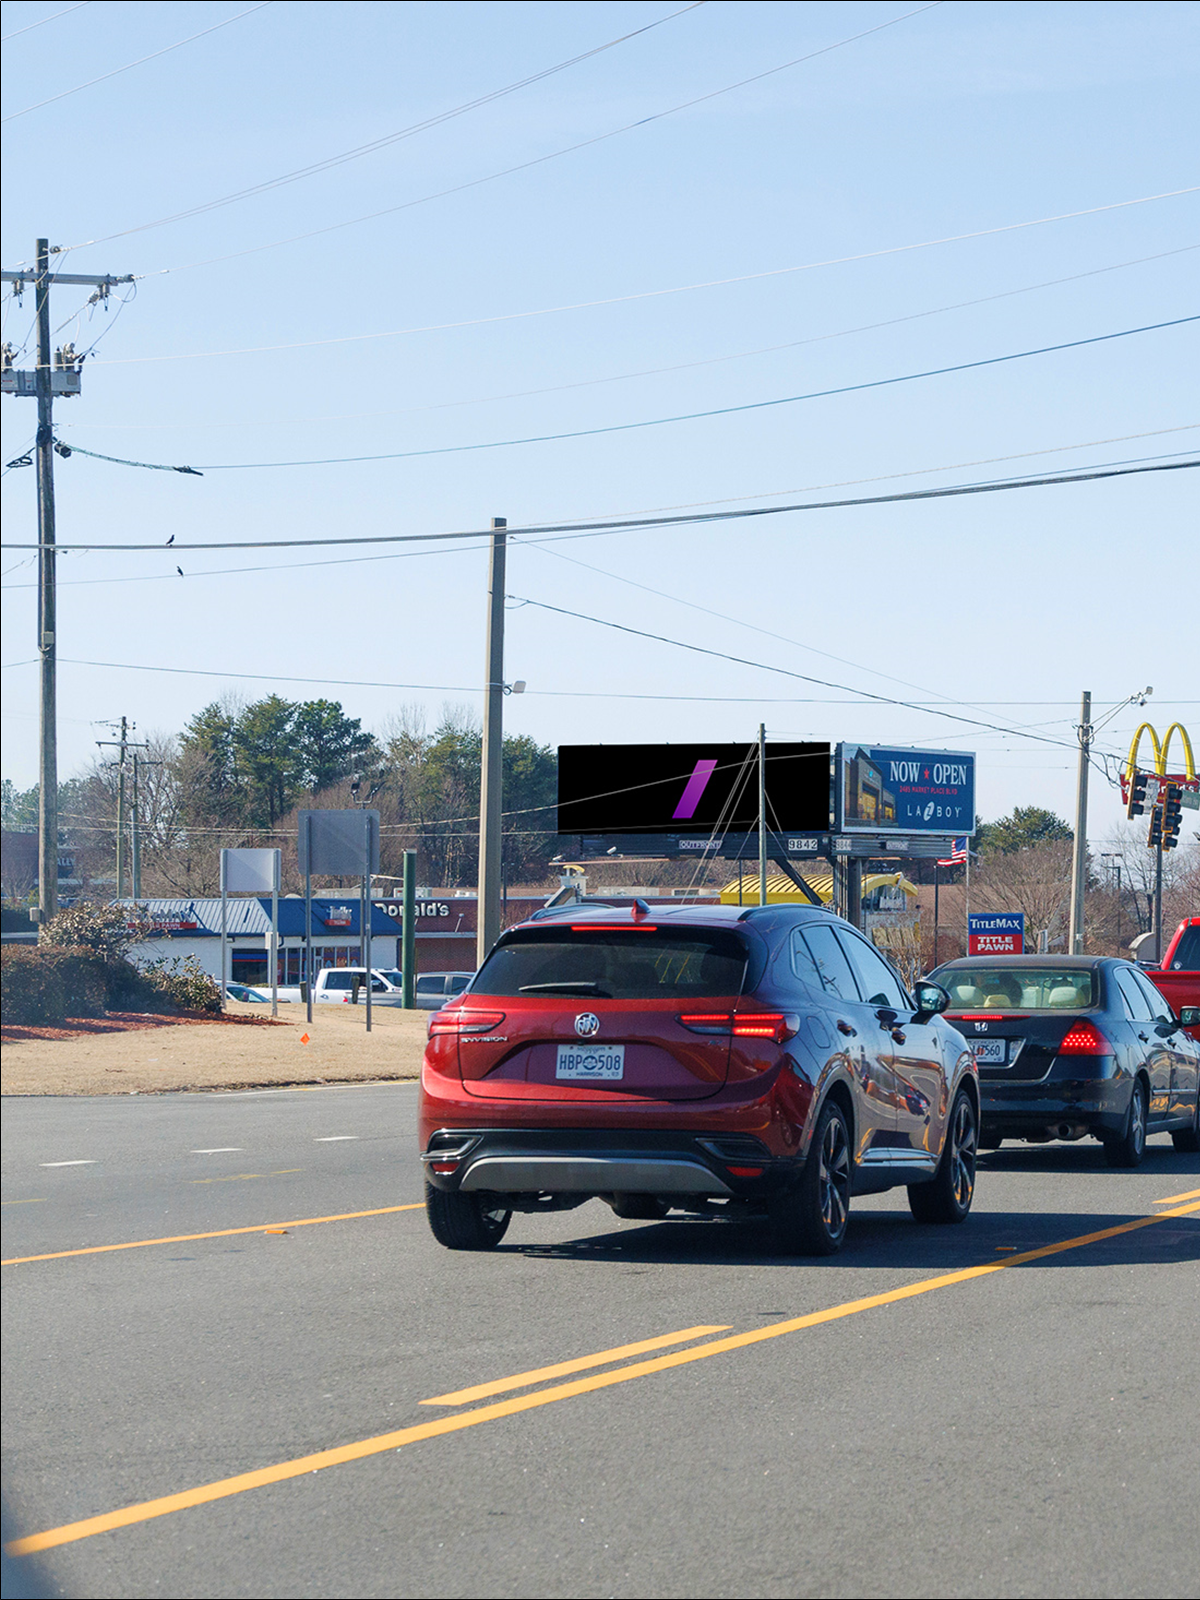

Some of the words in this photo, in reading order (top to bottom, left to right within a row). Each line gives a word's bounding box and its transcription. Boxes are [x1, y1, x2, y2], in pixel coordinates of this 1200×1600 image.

[890, 761, 920, 783] NOW
[933, 763, 967, 785] OPEN
[912, 786, 929, 794] MARKET
[930, 787, 945, 795] PLACE
[788, 839, 817, 850] 9842
[978, 936, 1013, 944] TITLE
